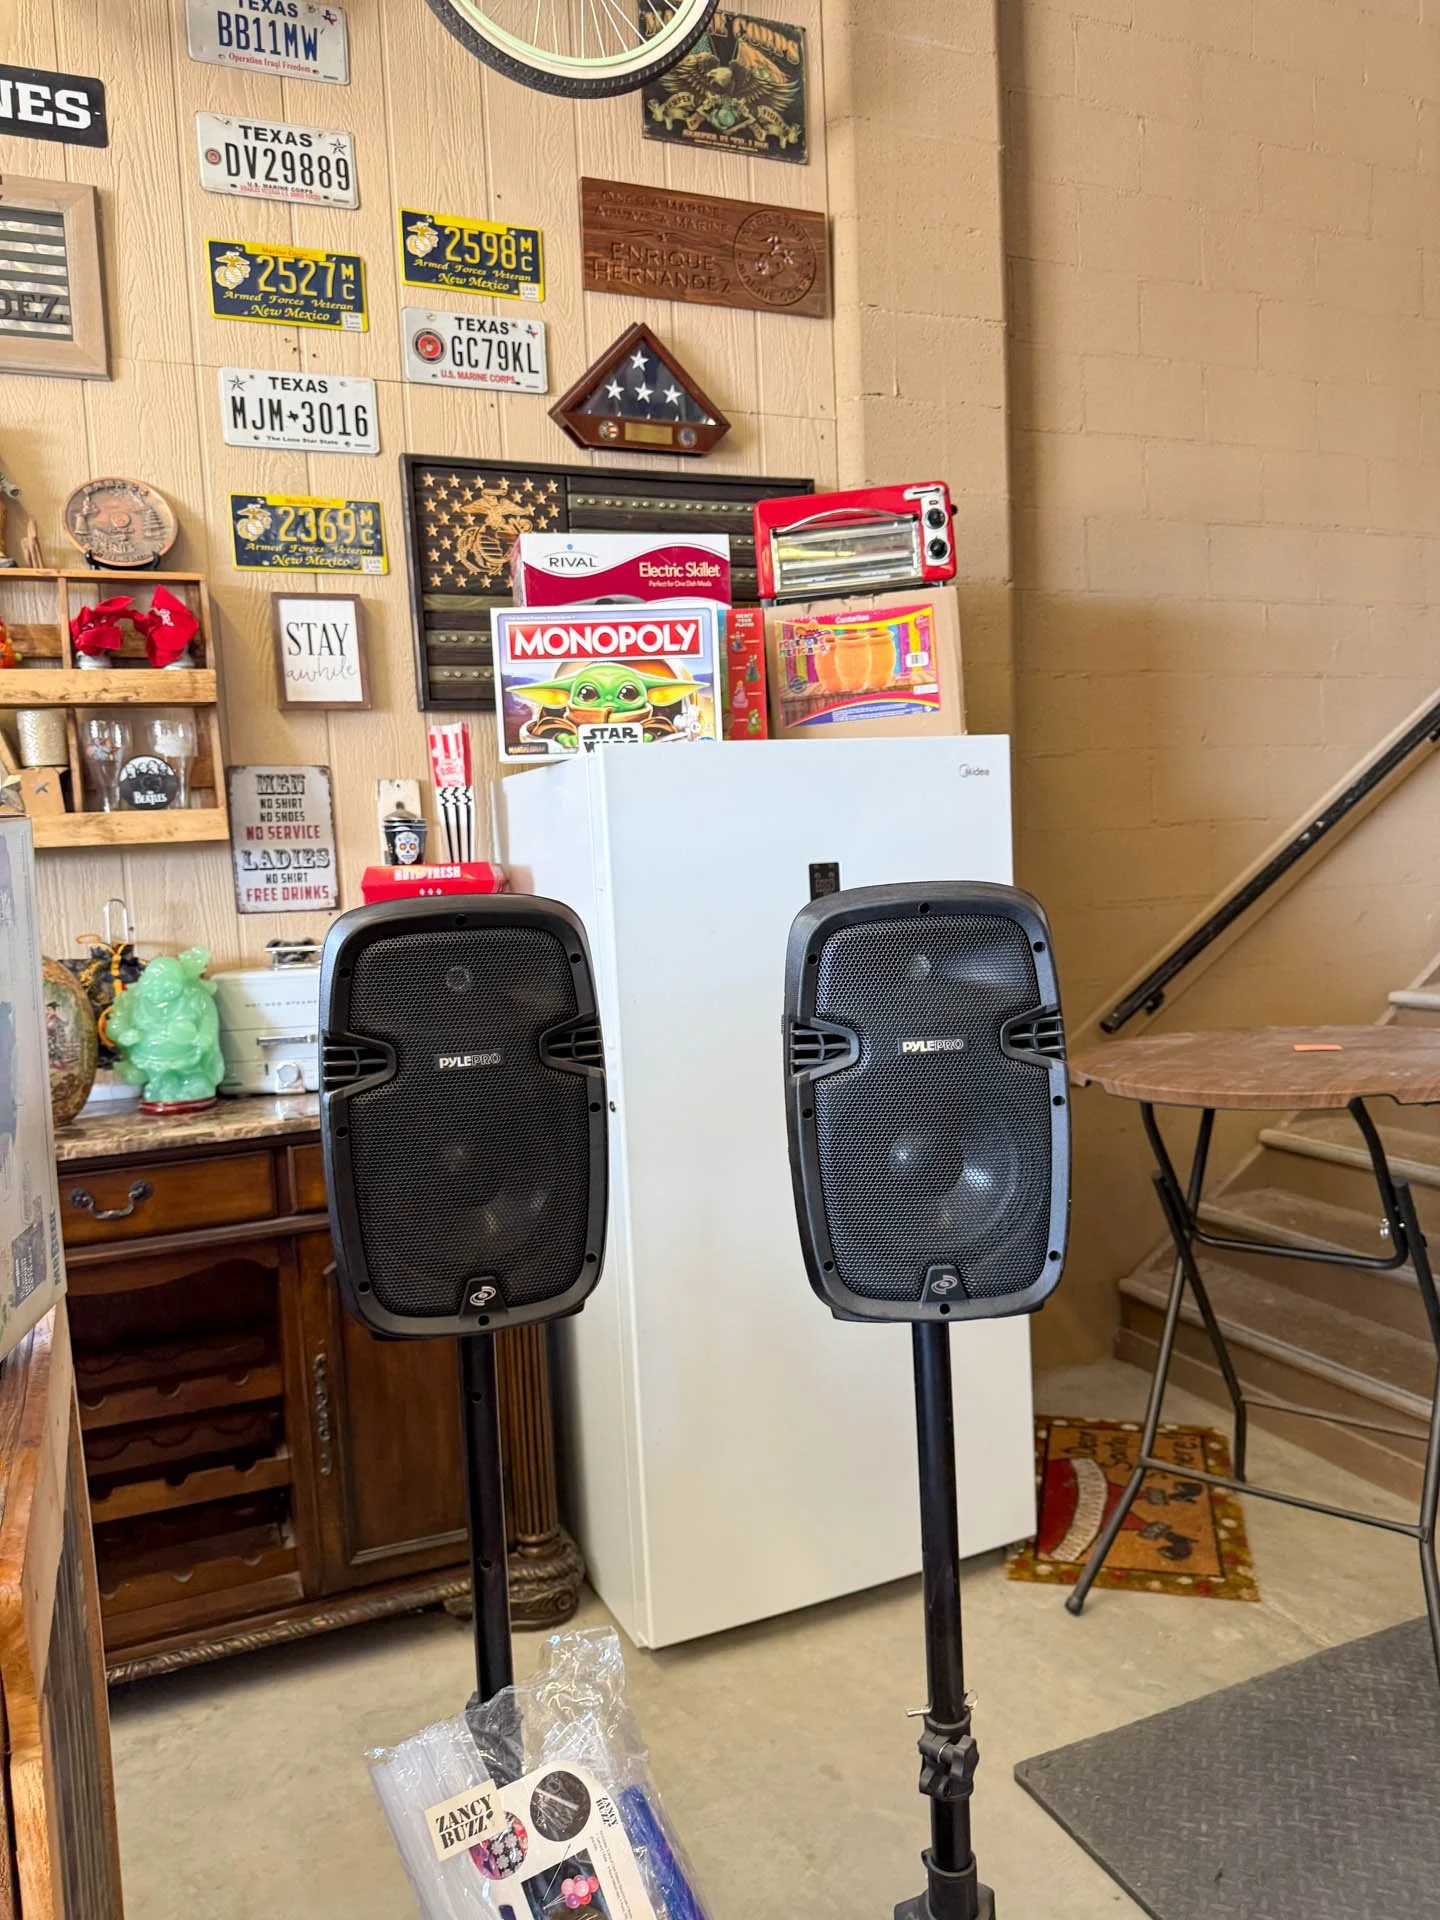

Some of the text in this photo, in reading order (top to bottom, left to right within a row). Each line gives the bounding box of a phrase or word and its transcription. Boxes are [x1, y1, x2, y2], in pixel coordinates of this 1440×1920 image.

[238, 0, 298, 18] TEXAS
[218, 11, 317, 61] BB11MW
[229, 52, 262, 65] Operation
[282, 62, 311, 73] Freedom
[239, 125, 313, 147] TEXAS
[225, 142, 350, 191] DV29889
[263, 183, 289, 191] MARINE
[444, 226, 516, 270] 2598
[610, 242, 715, 272] ENRIQUE
[256, 255, 336, 298] 2527
[414, 259, 531, 282] Armed Forces Veteran
[592, 258, 733, 295] HERNANDEZ
[438, 273, 510, 291] New Mexico
[223, 290, 354, 311] Armed Forces Veteran
[251, 304, 330, 321] New Mexico
[454, 317, 509, 335] TEXAS
[451, 335, 540, 374] GC79KL
[268, 376, 328, 393] TEXAS
[440, 370, 516, 384] U.S. MARINE CORPS
[278, 506, 357, 544] 2369
[245, 542, 374, 556] Armed Forces Veteran
[272, 554, 350, 568] New Mexico
[549, 556, 598, 568] RIVAL
[639, 562, 721, 578] Electric Skillet
[286, 622, 349, 656] STAY
[514, 619, 697, 657] MONOPOLY
[583, 727, 638, 740] STAR
[256, 774, 305, 795] MEN
[260, 798, 303, 809] NO SHIRT
[260, 811, 305, 822] NO SHOES
[246, 825, 320, 840] NO SERVICE
[242, 849, 331, 870] LADIES
[265, 873, 308, 884] NO SHIRT
[427, 866, 461, 879] FRESH
[246, 885, 329, 902] FREE DRINKS
[435, 1794, 491, 1834] ZANCY
[596, 1798, 611, 1824] BUZZ
[601, 1796, 618, 1825] ZANCY
[440, 1816, 488, 1850] BUZZ
